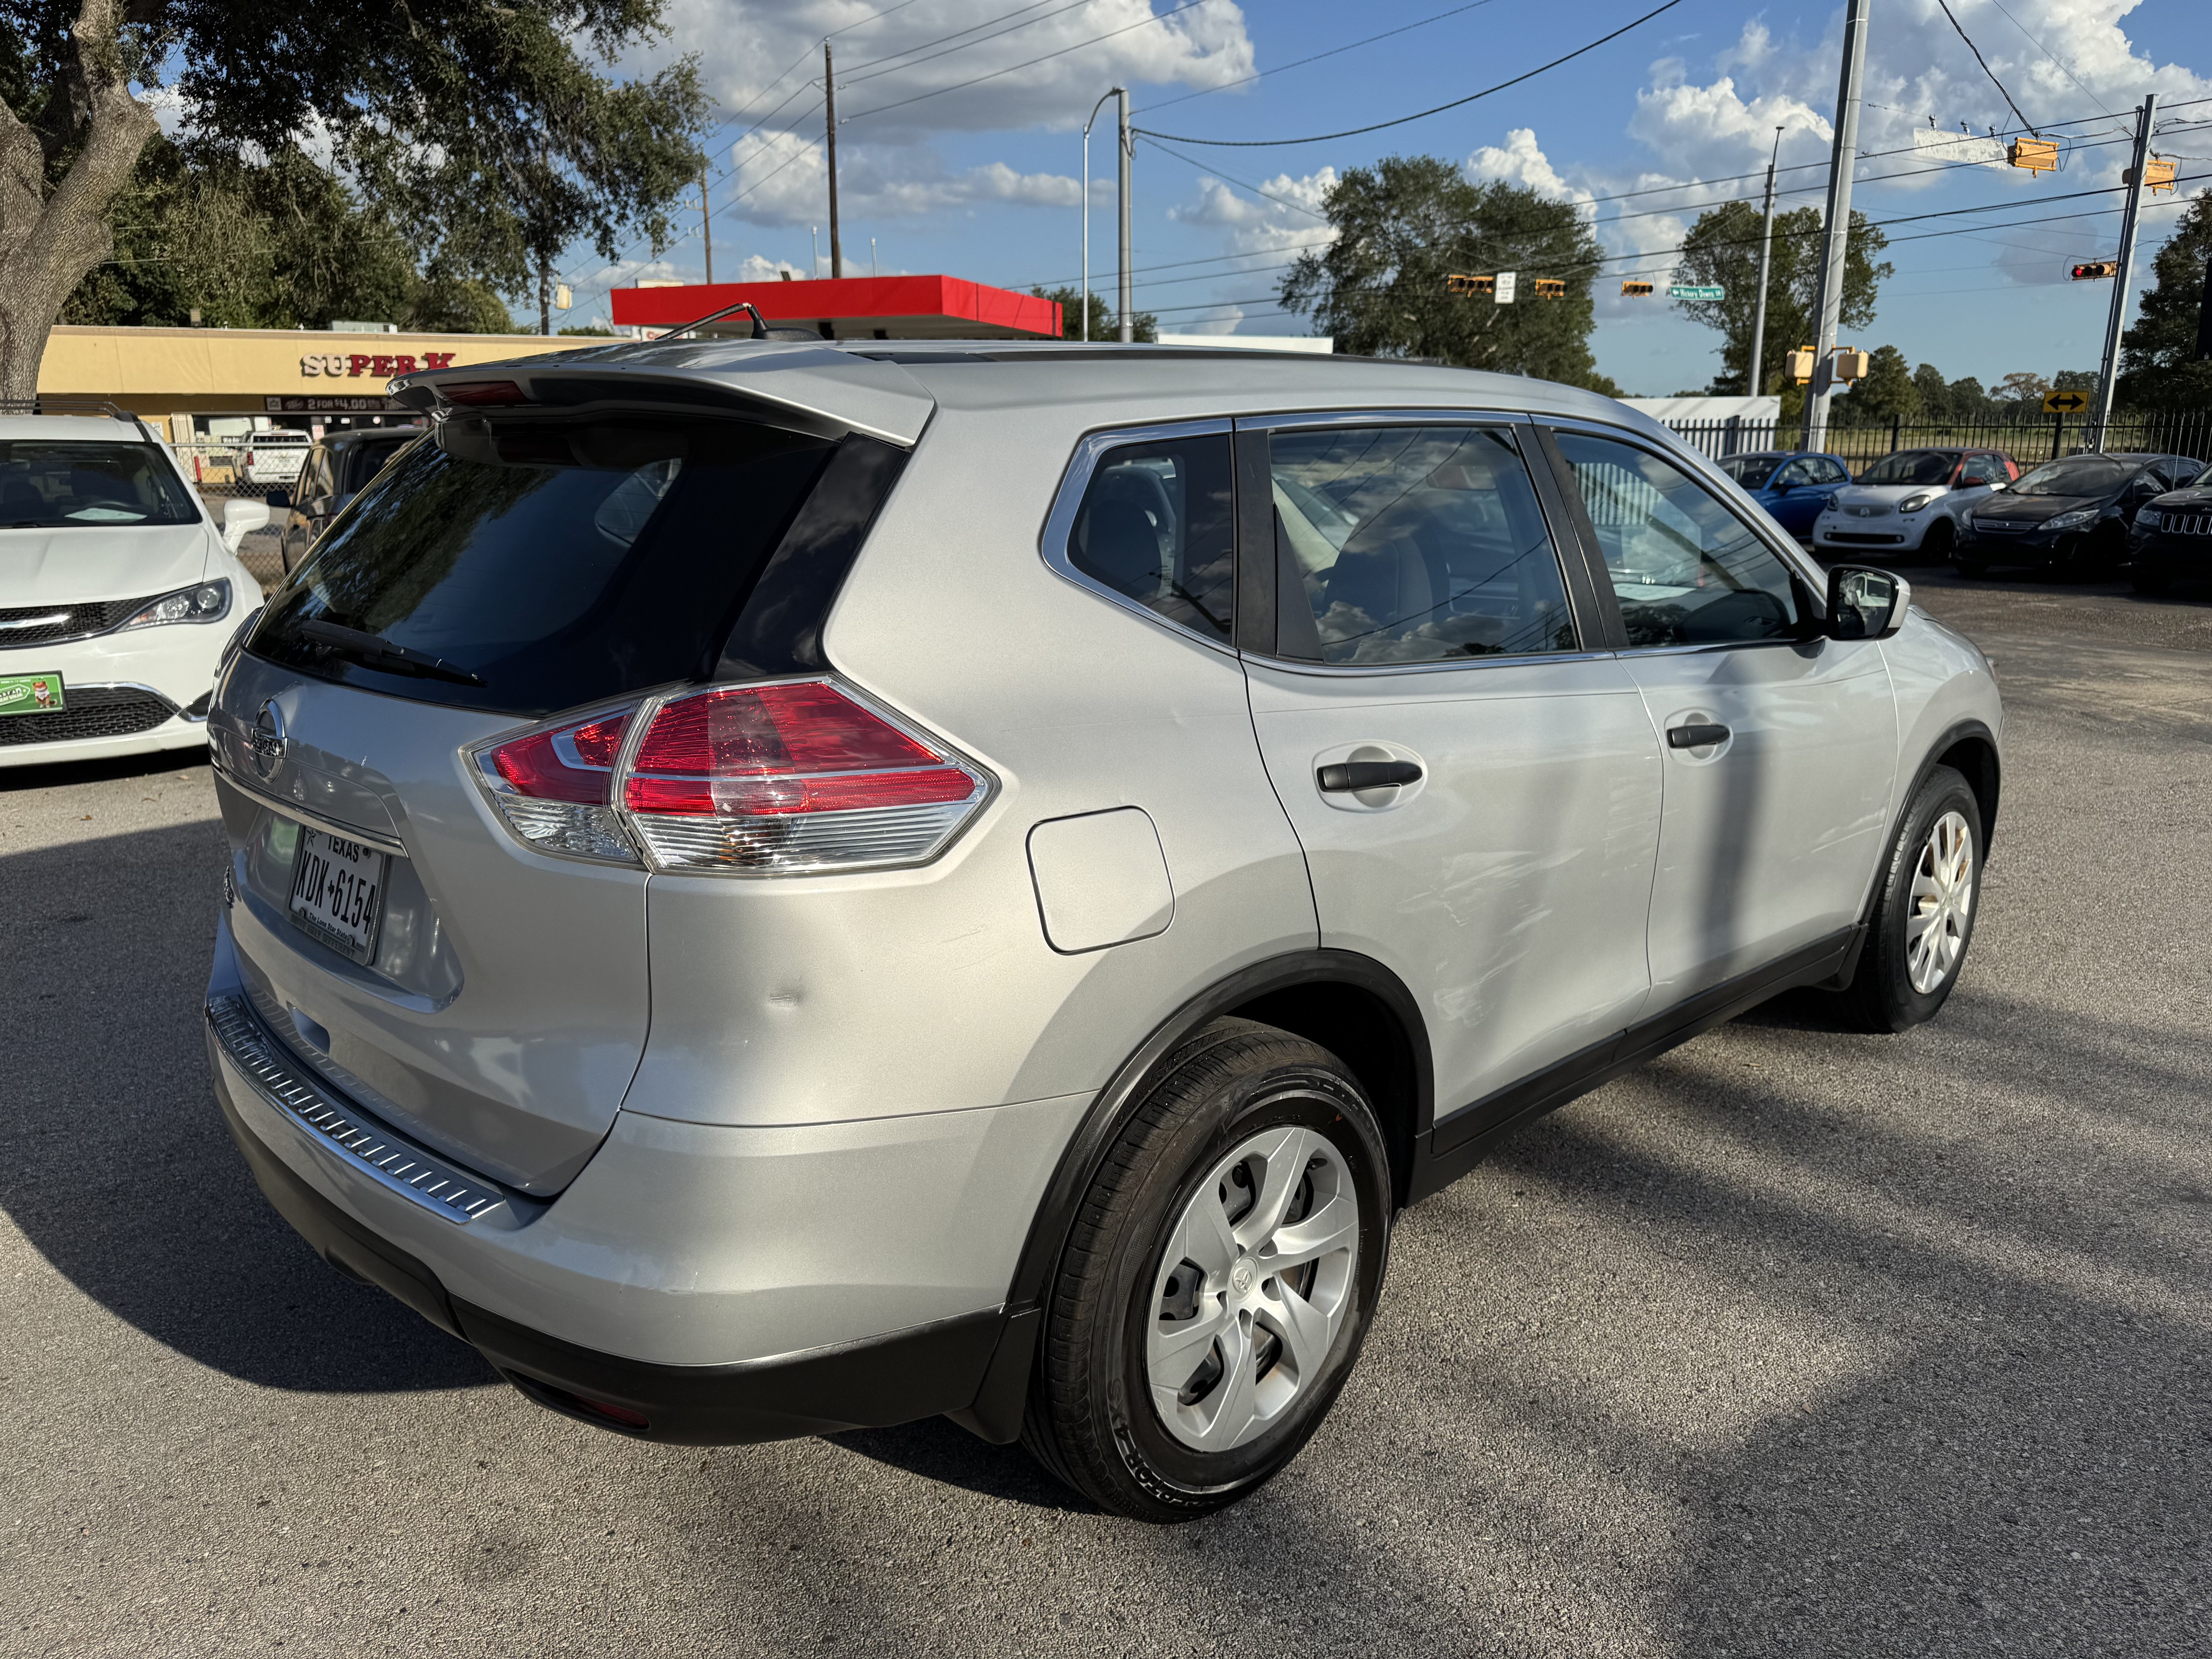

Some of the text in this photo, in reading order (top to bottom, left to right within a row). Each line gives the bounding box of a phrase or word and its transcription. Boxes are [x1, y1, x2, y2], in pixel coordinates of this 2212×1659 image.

[302, 353, 455, 376] SUPER K
[308, 398, 316, 409] 2
[317, 399, 333, 409] FOR
[334, 398, 367, 410] $4.00
[328, 835, 359, 863] TEXAS
[296, 850, 330, 908] KDK
[332, 869, 376, 934] 6154
[317, 917, 327, 928] Lone
[327, 923, 337, 933] Star
[336, 928, 348, 940] State
[1170, 1127, 1203, 1171] OUTSIDE
